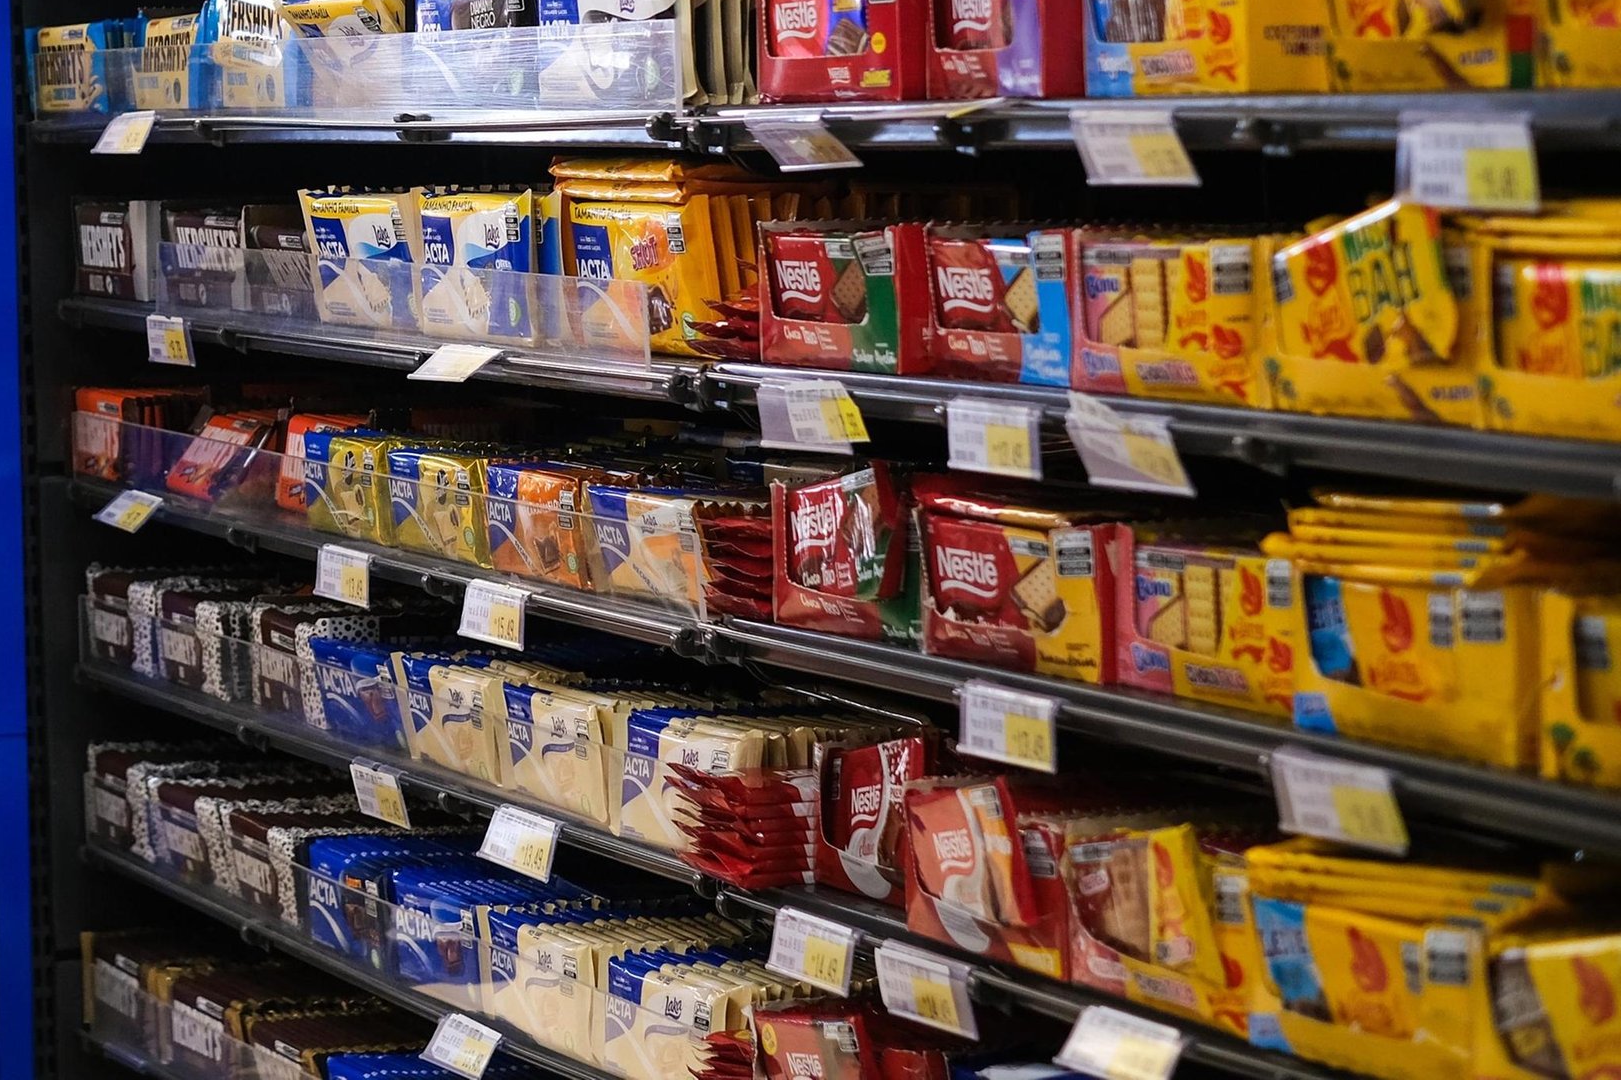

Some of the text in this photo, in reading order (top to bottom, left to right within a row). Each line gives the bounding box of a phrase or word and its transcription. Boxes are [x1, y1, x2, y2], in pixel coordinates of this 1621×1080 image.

[471, 12, 495, 30] NEGRO
[774, 0, 817, 30] Nestlé
[311, 200, 359, 214] TAMANHO FAMÍLIA
[81, 224, 126, 268] HERSHEY'S
[372, 225, 391, 249] Laka
[484, 223, 500, 249] Laka
[424, 244, 449, 263] ACTA
[631, 234, 659, 271] SHOT
[576, 259, 610, 279] LACTA
[775, 260, 820, 291] Nestlé
[936, 266, 994, 301] Nestlé
[389, 478, 414, 499] LACTA
[790, 501, 834, 541] Nestlé
[595, 524, 626, 546] LACTA
[936, 545, 998, 586] Nestlé
[802, 572, 821, 587] Choco
[408, 692, 431, 714] ACTA
[508, 721, 529, 744] ACTA
[623, 753, 650, 779] ACTA
[851, 784, 881, 815] Nestlé
[933, 828, 973, 859] Nestlé
[309, 876, 339, 909] ACTA
[396, 904, 432, 942] ACTA
[490, 949, 514, 972] ACTA
[664, 995, 682, 1018] Laka
[786, 1052, 822, 1077] Nestlé
